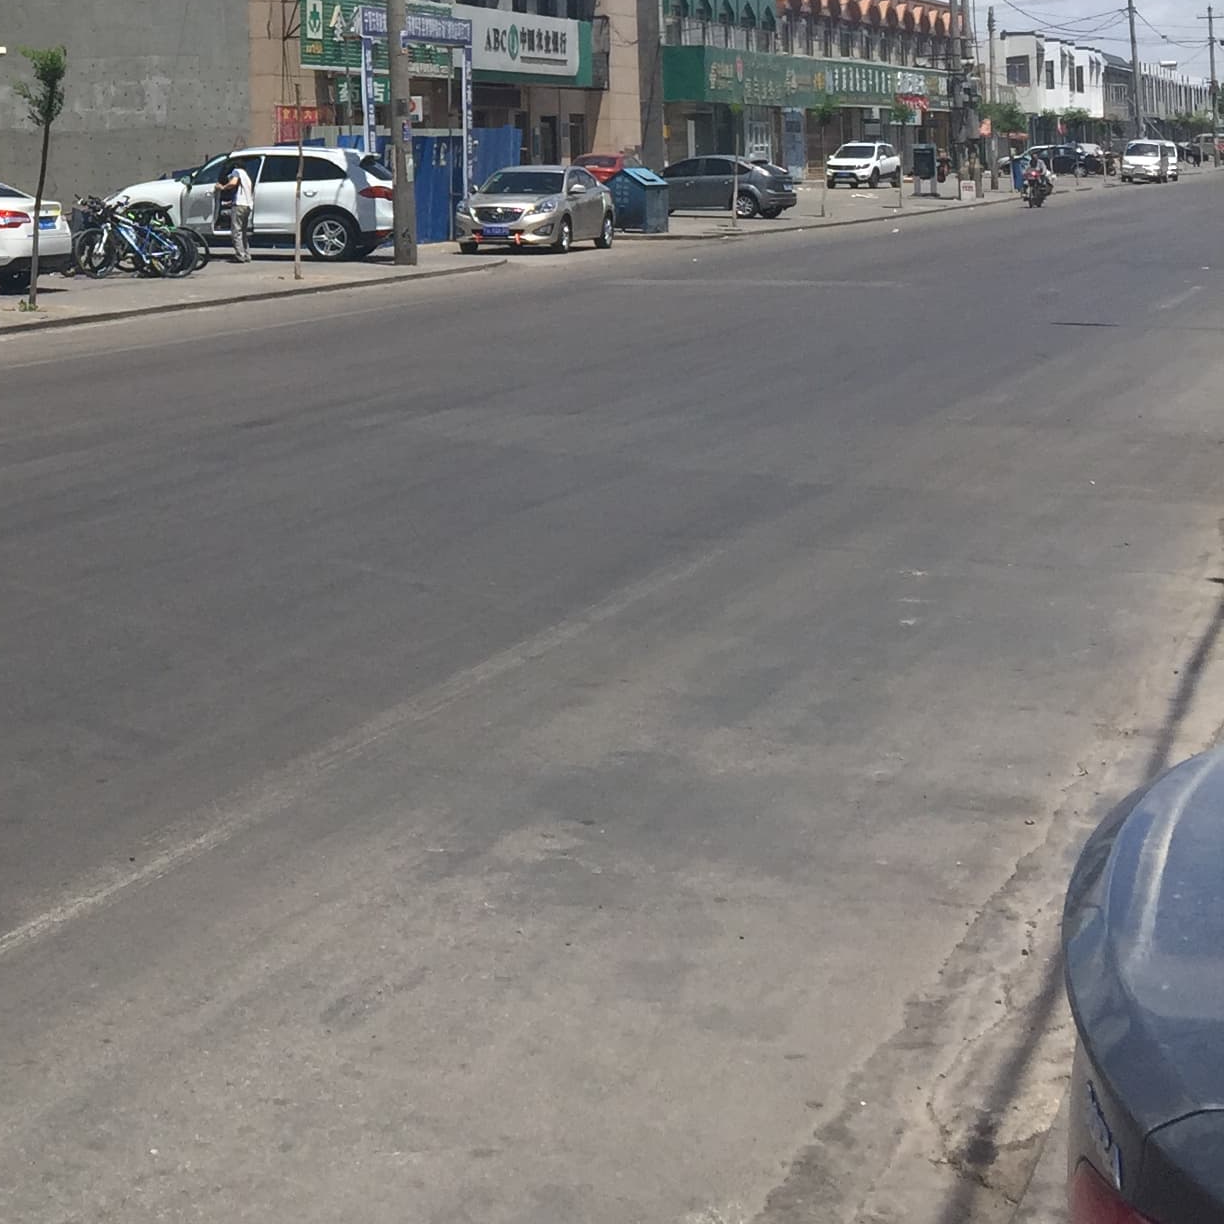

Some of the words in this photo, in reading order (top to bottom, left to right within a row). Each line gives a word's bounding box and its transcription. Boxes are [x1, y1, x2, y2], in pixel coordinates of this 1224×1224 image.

[484, 27, 508, 53] ABC
[519, 26, 568, 56] 中国农业银行
